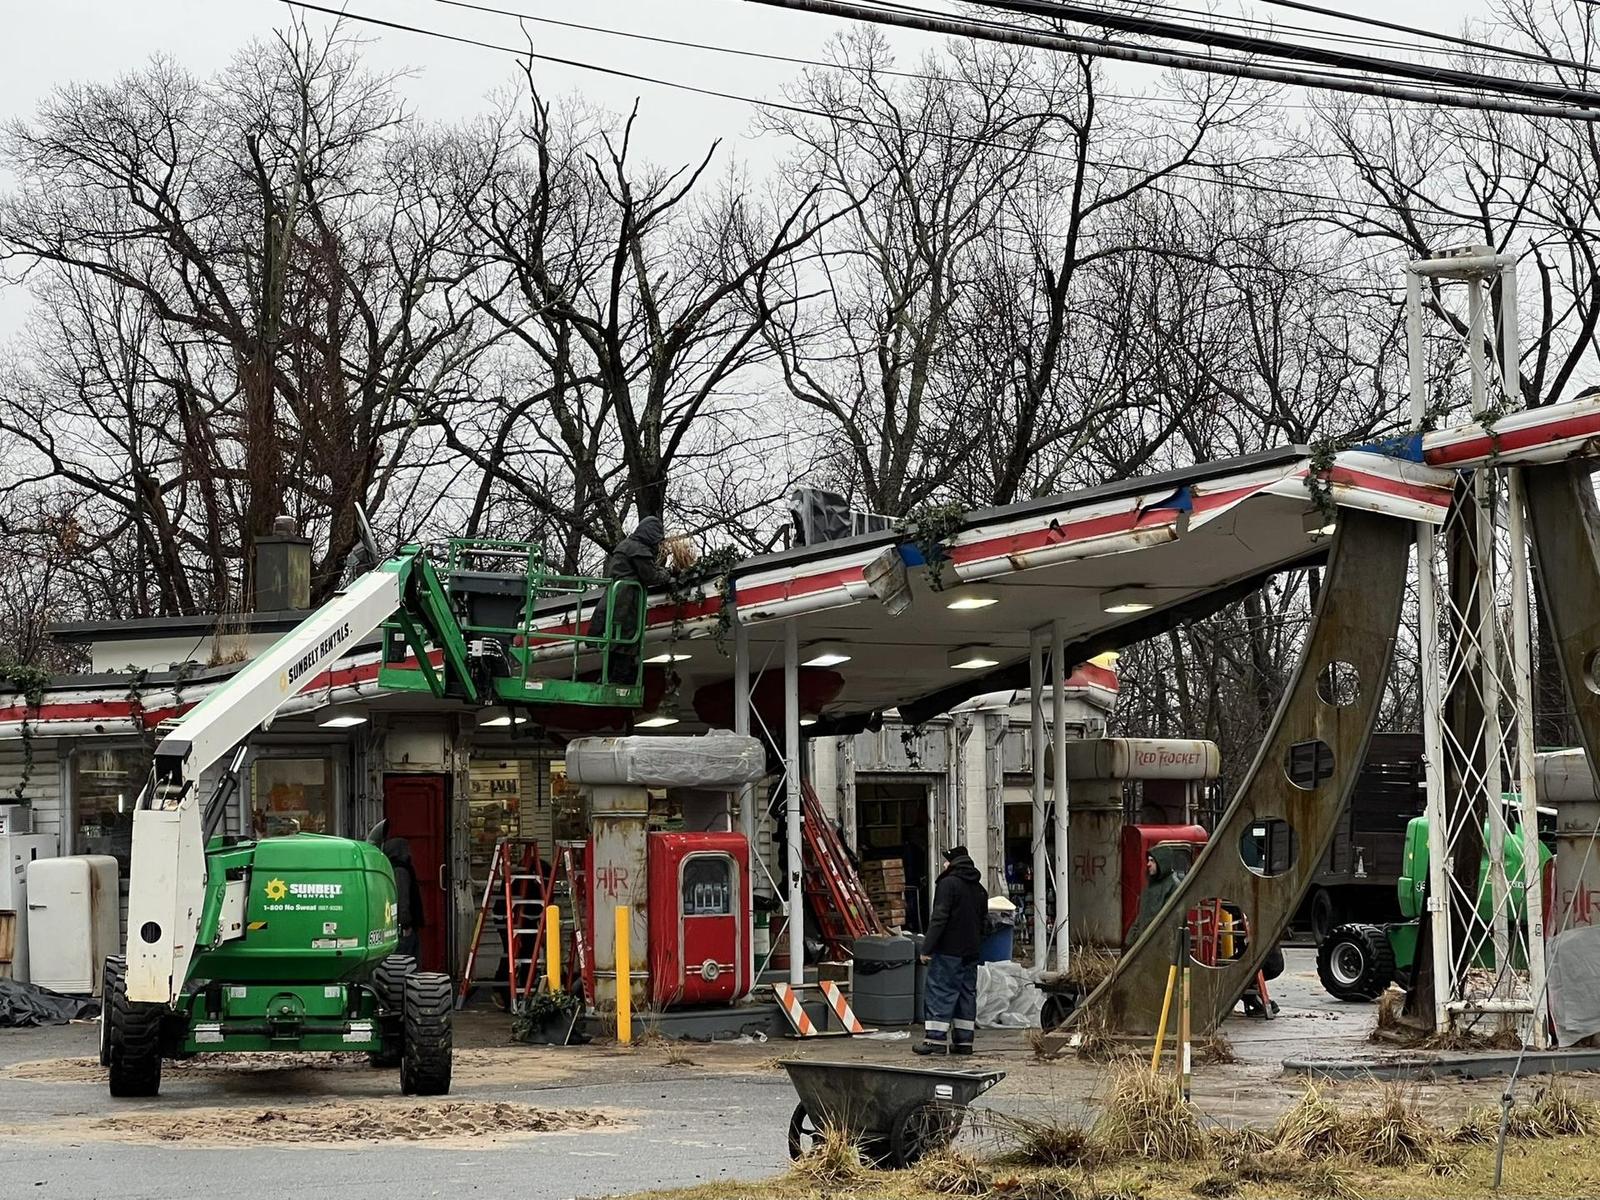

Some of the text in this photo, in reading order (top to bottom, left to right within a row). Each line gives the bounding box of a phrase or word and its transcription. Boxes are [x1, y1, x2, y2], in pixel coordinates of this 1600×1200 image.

[1135, 750, 1201, 768] RED ROCKET
[290, 884, 341, 895] SUNBELT
